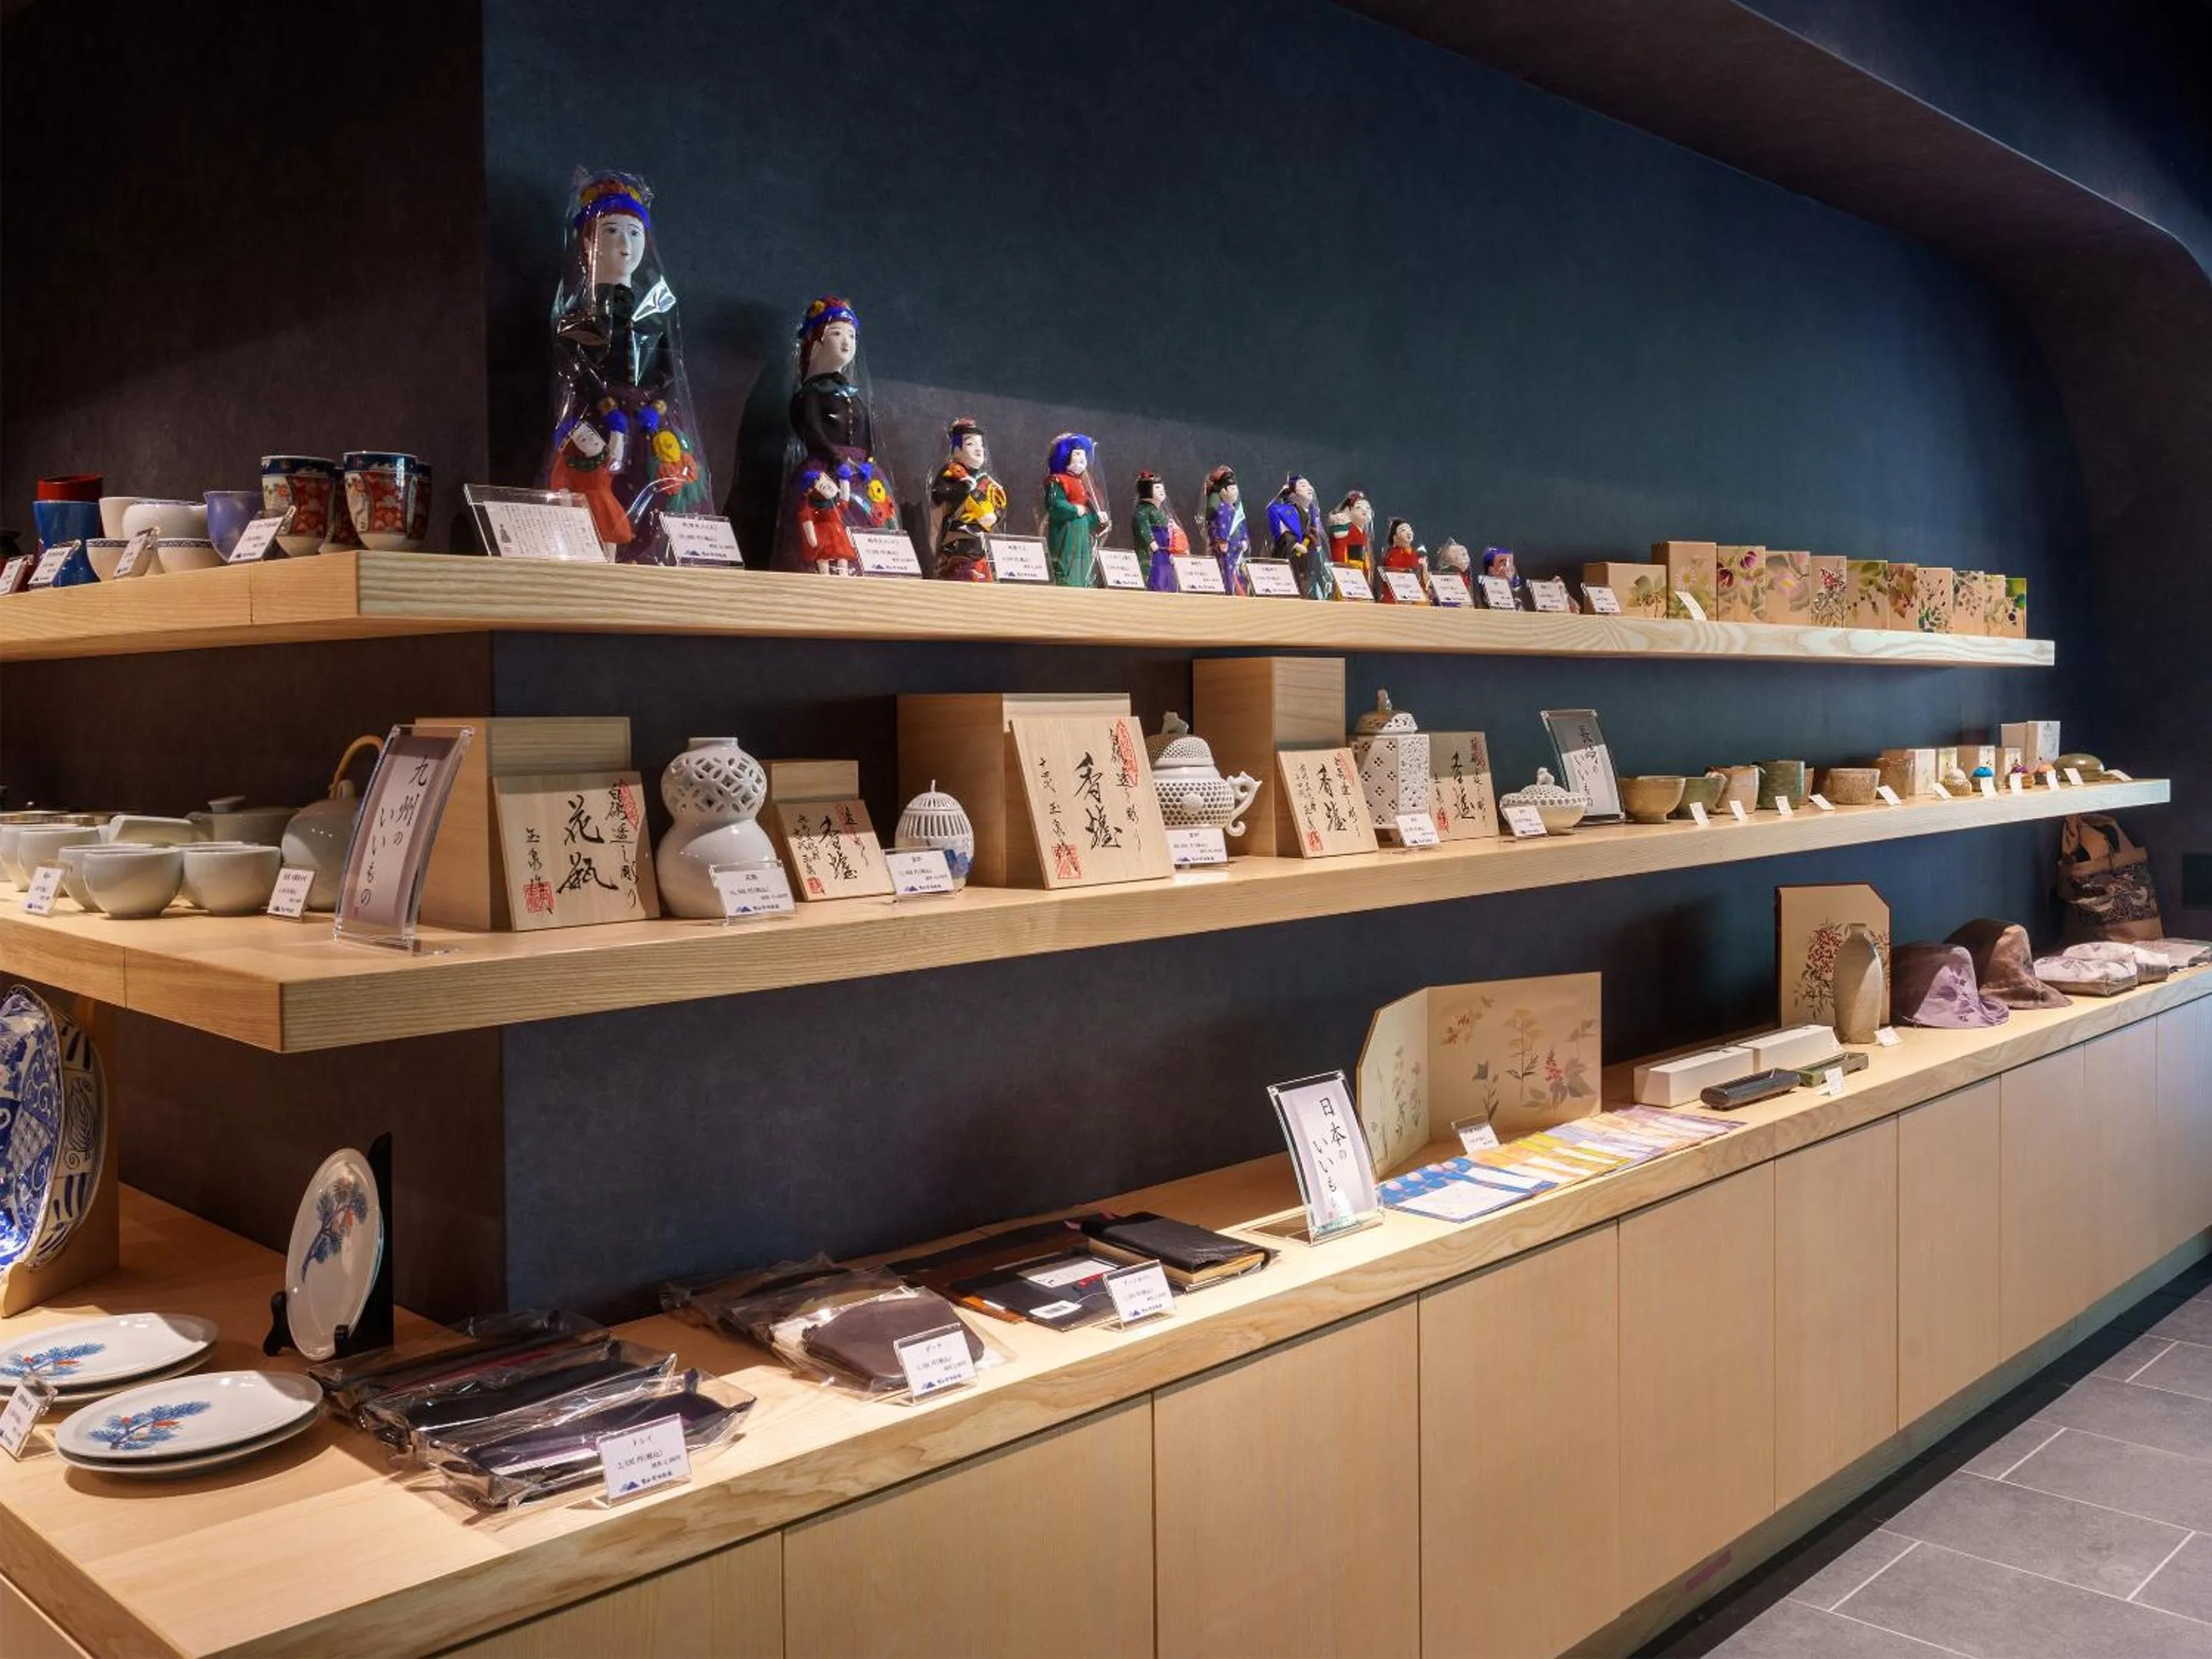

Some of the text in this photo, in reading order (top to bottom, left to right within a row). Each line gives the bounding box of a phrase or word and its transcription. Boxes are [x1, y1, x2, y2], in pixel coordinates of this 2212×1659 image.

[393, 756, 429, 846] 九州の
[556, 794, 618, 893] 花瓶
[361, 807, 393, 906] いいもの
[1320, 1097, 1346, 1160] 日本の
